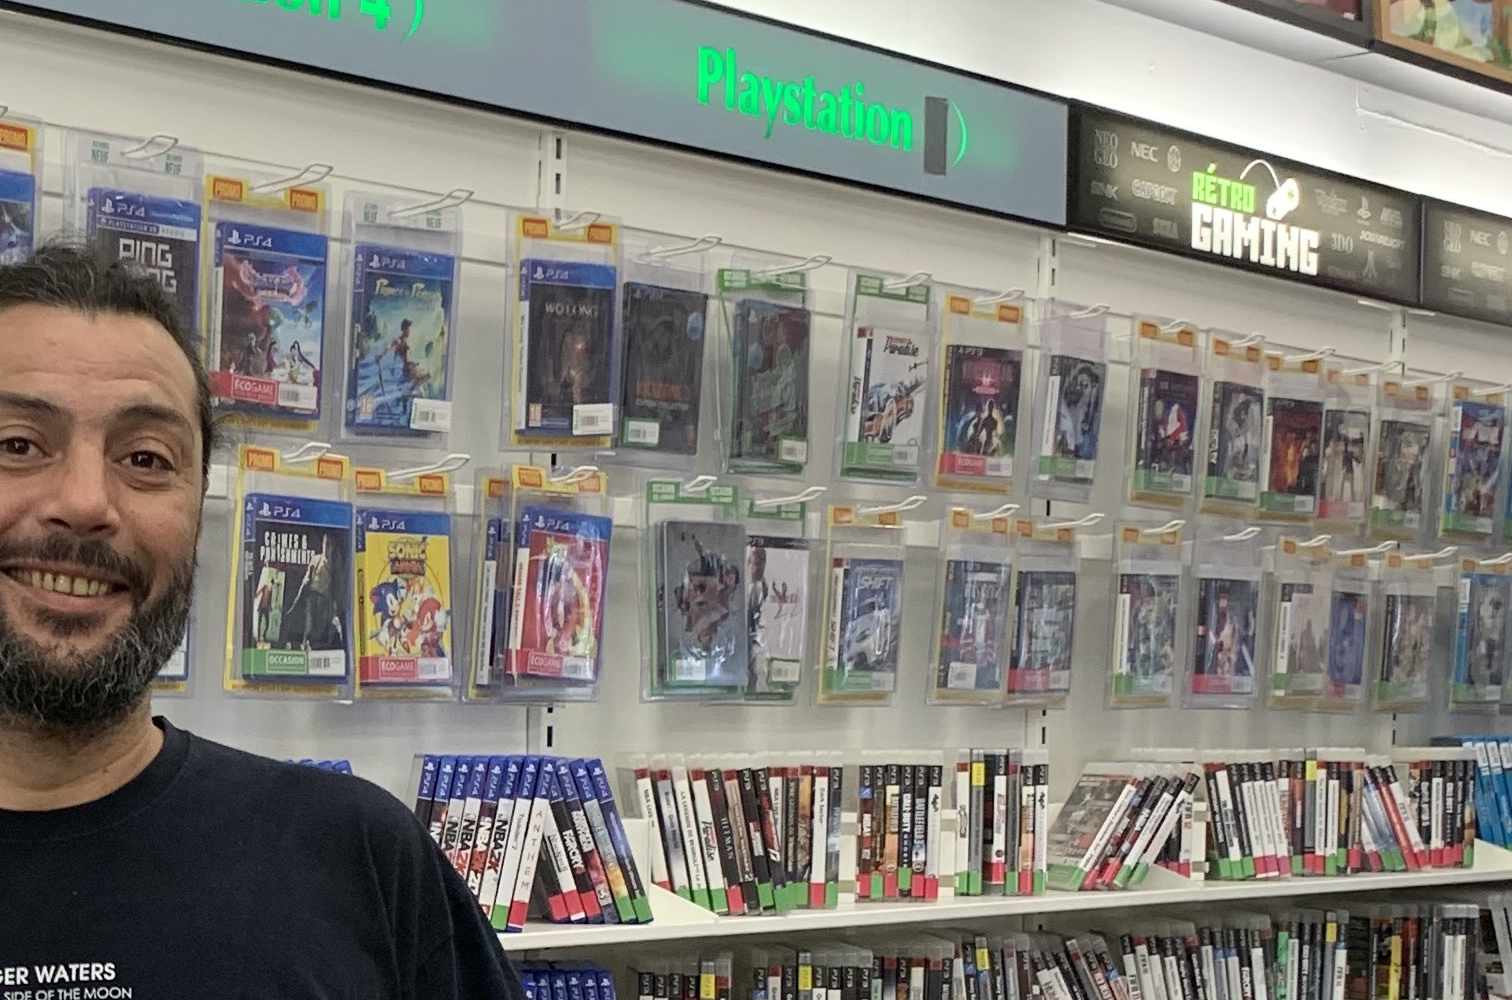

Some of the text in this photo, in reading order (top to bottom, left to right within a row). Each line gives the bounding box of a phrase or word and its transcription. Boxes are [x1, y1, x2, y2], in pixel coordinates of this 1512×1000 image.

[697, 45, 914, 151] Playstation
[1131, 141, 1159, 162] NEC
[1191, 163, 1256, 214] RÉTRO
[116, 202, 145, 217] PS4
[244, 234, 273, 248] PS4
[1191, 202, 1320, 276] GAMING
[119, 238, 173, 268] PING
[380, 259, 406, 270] PS4
[273, 506, 301, 519] PS4
[382, 519, 406, 531] PS4
[388, 539, 428, 561] SONIC
[860, 575, 893, 589] SHIFT
[442, 821, 459, 850] NBA
[459, 818, 476, 851] NBA
[477, 820, 492, 851] NBA
[491, 818, 508, 853] NBA
[720, 817, 733, 860] HITMAN
[34, 963, 116, 984] WATERS
[57, 988, 81, 1000] THE
[83, 986, 133, 1000] MOON
